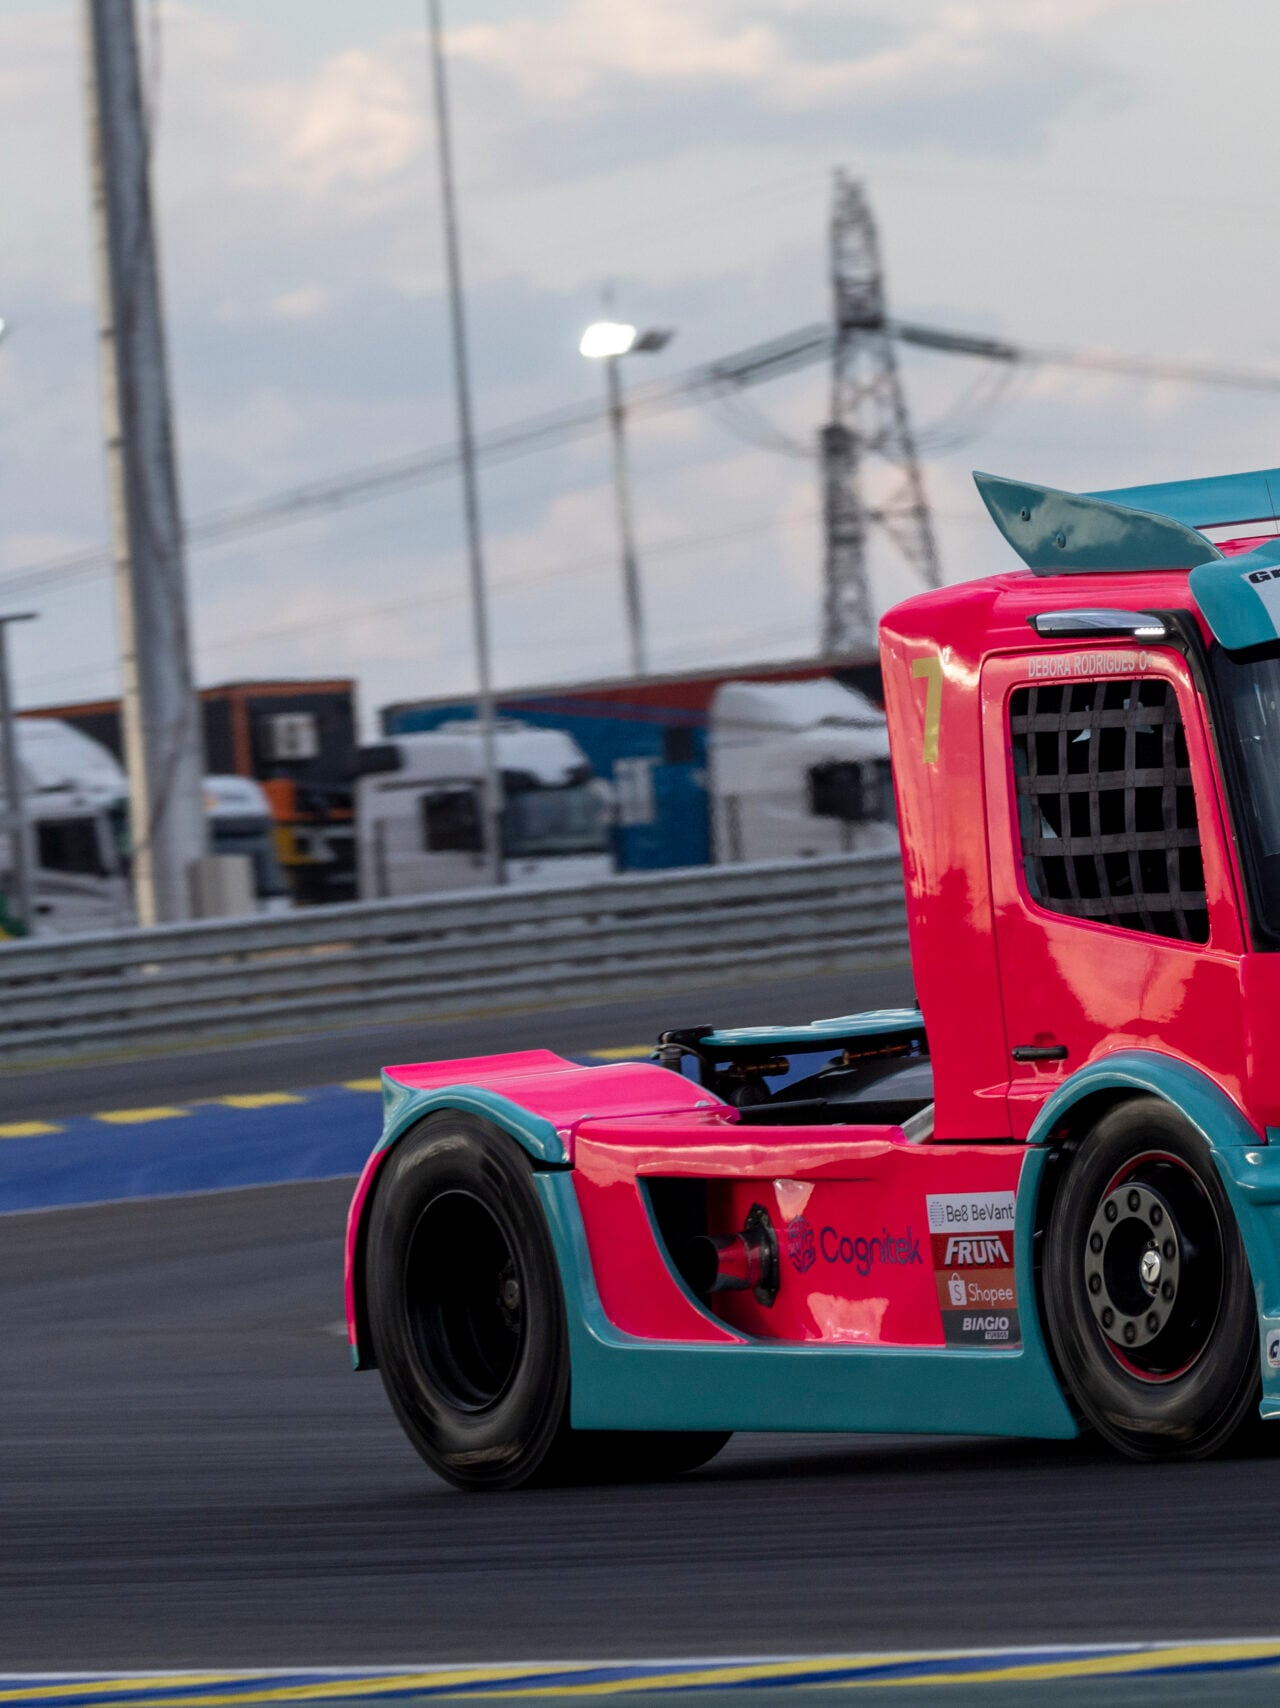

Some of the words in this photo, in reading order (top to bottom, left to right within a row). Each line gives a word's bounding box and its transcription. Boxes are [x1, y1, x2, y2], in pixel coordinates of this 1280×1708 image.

[1028, 655, 1071, 678] DEBORA
[1074, 650, 1135, 675] RODRIGUES
[912, 656, 944, 763] 7
[946, 1204, 969, 1222] Be8
[971, 1202, 1014, 1221] BeVant
[820, 1226, 923, 1276] Cognitek
[944, 1235, 1010, 1266] FRUM
[968, 1283, 1014, 1306] Shopee
[962, 1316, 1009, 1331] BIAGIO
